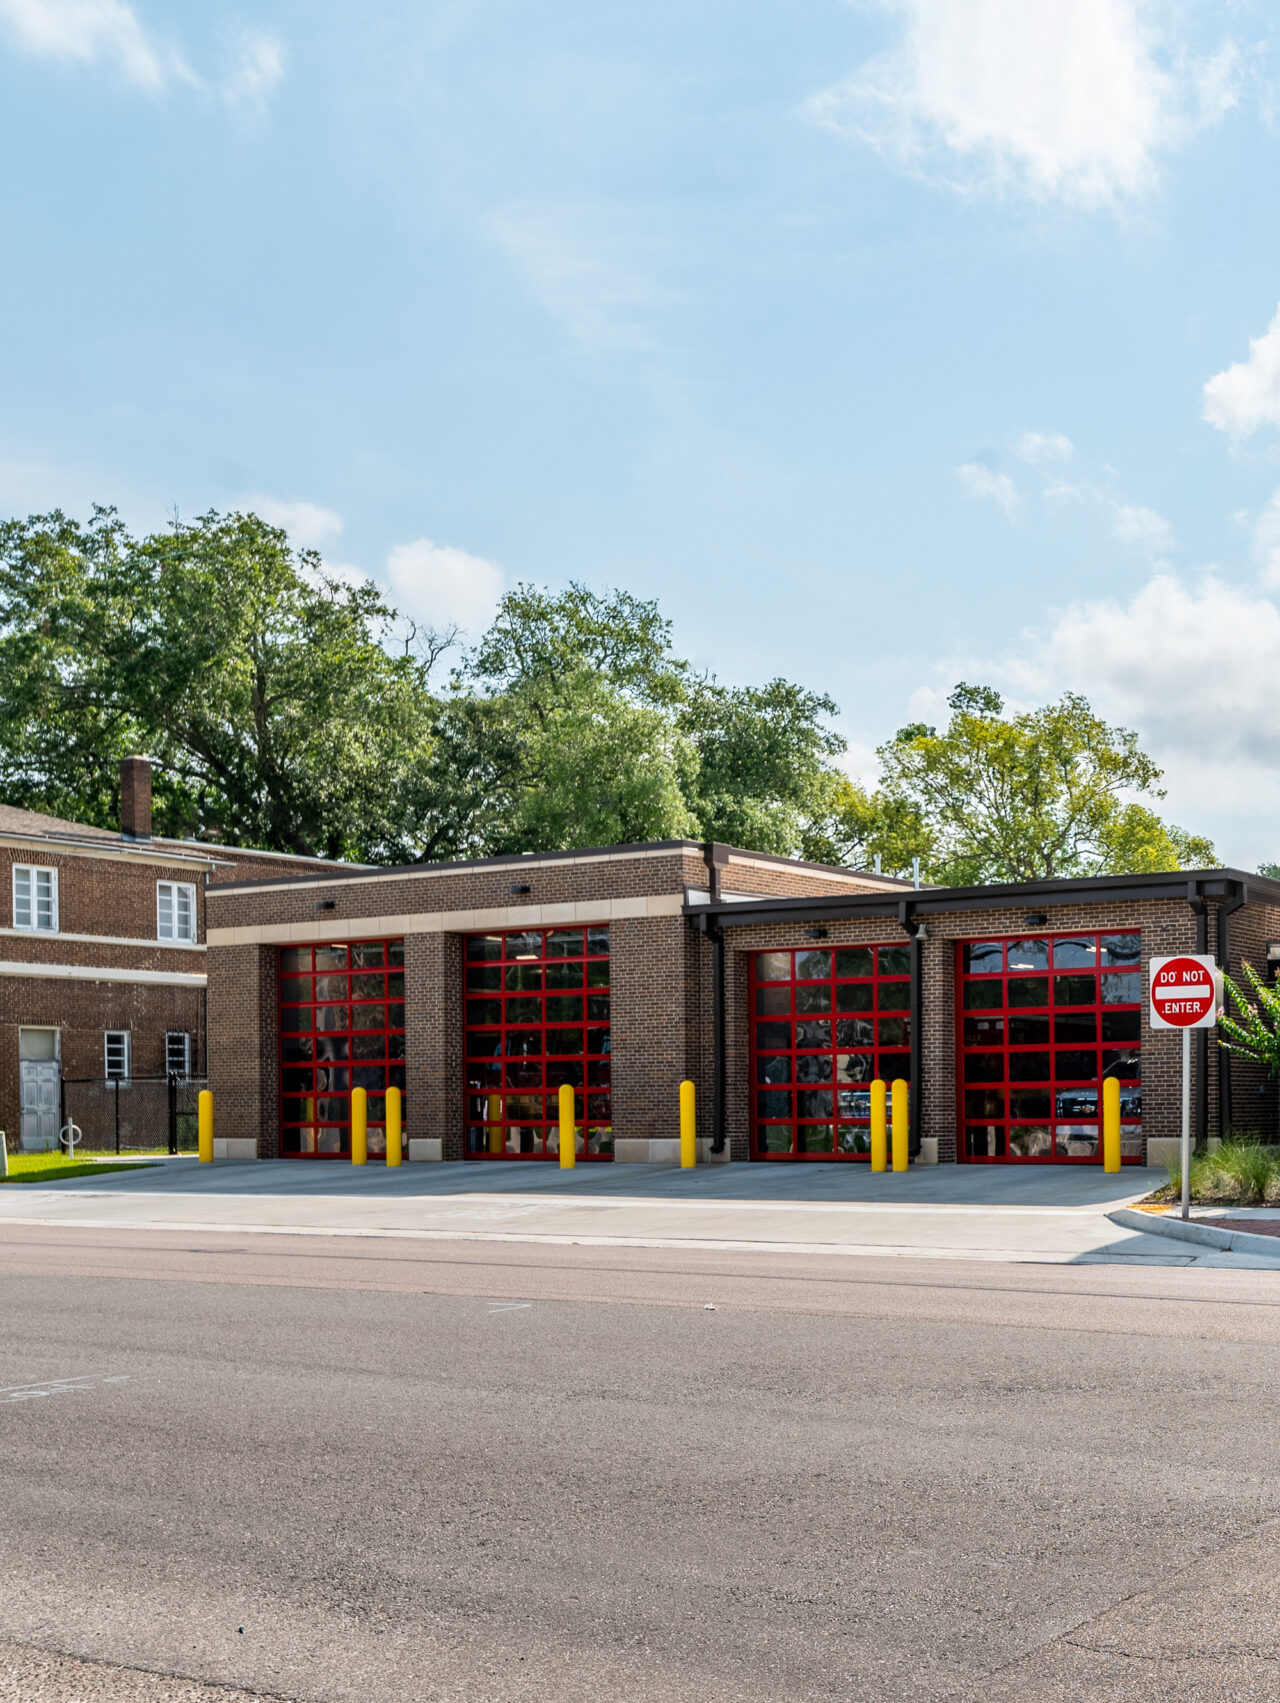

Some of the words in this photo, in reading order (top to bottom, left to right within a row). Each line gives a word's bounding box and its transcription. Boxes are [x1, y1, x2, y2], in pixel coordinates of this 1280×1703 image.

[1160, 971, 1176, 983] DO
[1182, 970, 1205, 982] NOT
[1164, 1001, 1201, 1014] ENTER
